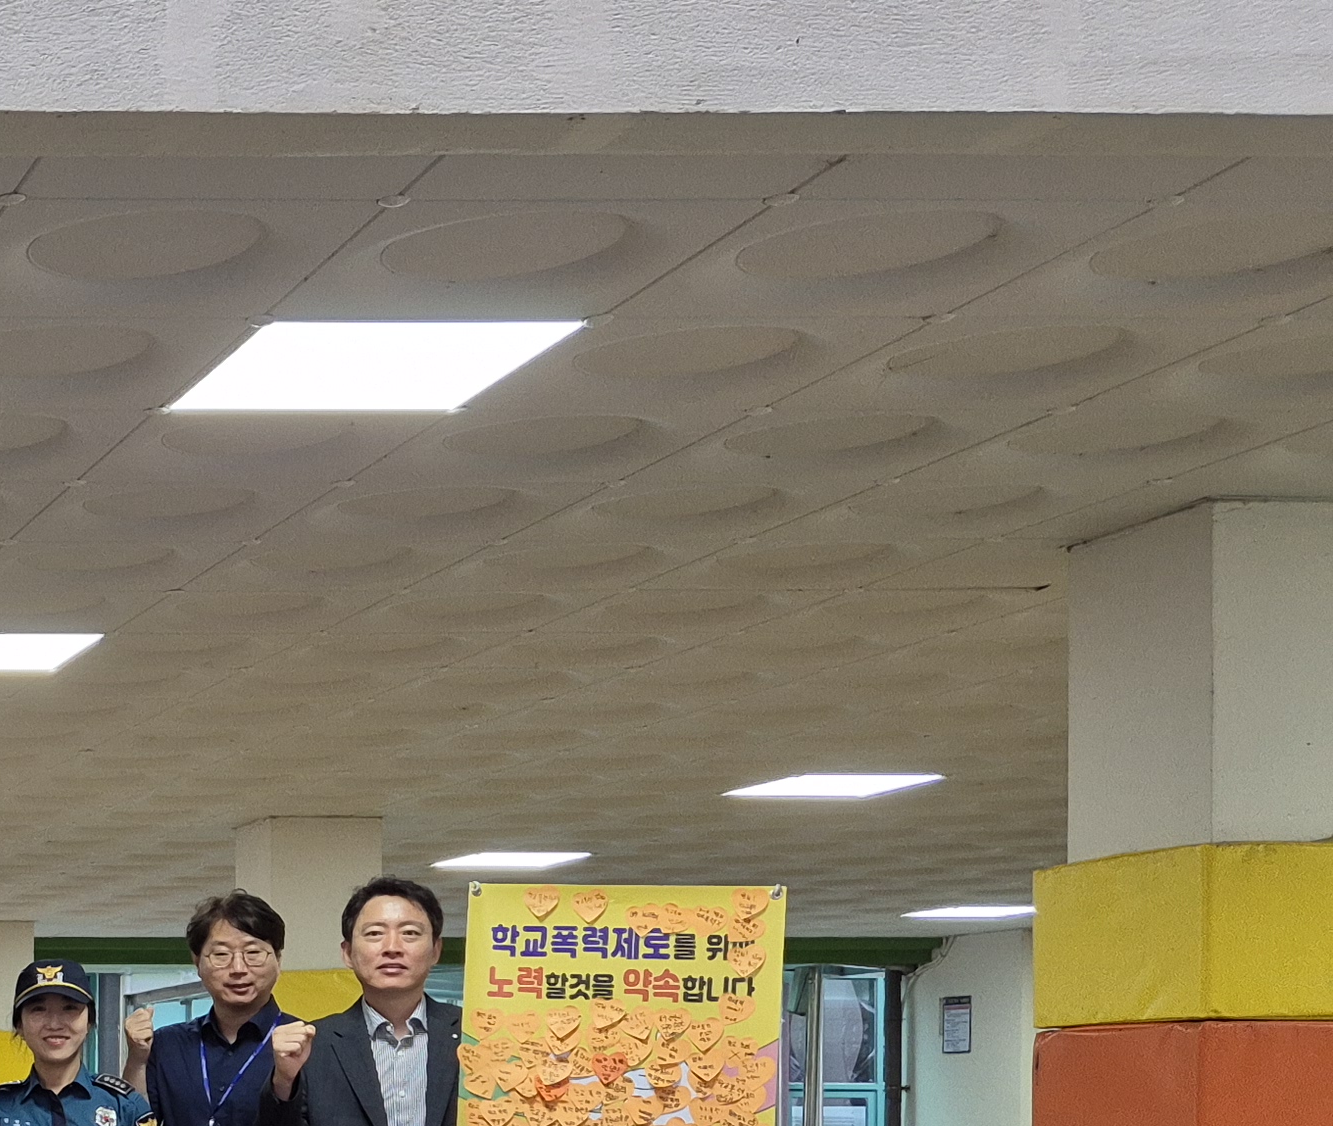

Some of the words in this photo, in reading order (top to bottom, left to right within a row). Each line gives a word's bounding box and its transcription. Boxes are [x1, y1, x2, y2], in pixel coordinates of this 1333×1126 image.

[491, 924, 696, 960] 학교폭력제로를
[487, 966, 615, 1000] 노력할것을
[623, 968, 755, 1003] 약속합니다
